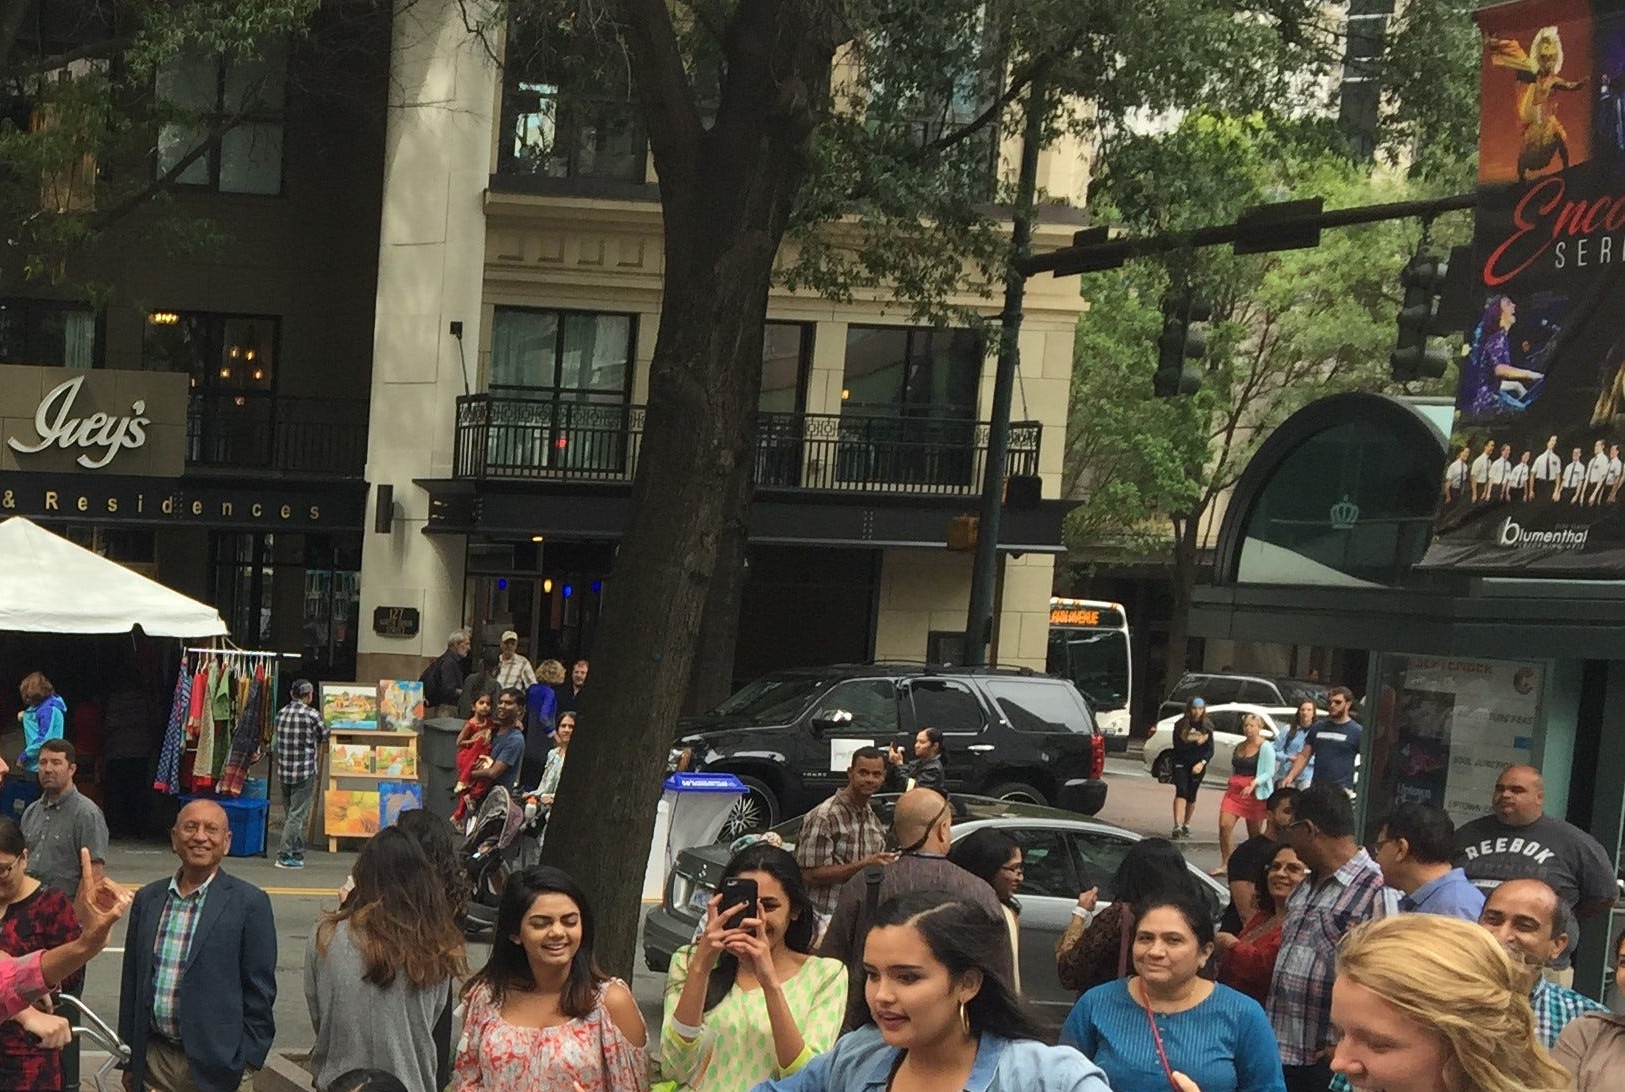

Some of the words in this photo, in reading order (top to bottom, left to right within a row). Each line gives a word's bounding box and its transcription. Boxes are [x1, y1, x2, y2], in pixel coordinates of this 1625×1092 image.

[7, 374, 151, 469] Ivey's
[1, 489, 15, 508] &
[45, 491, 320, 519] Residences
[1500, 516, 1589, 545] blumenthal
[1464, 837, 1555, 865] REEBOK
